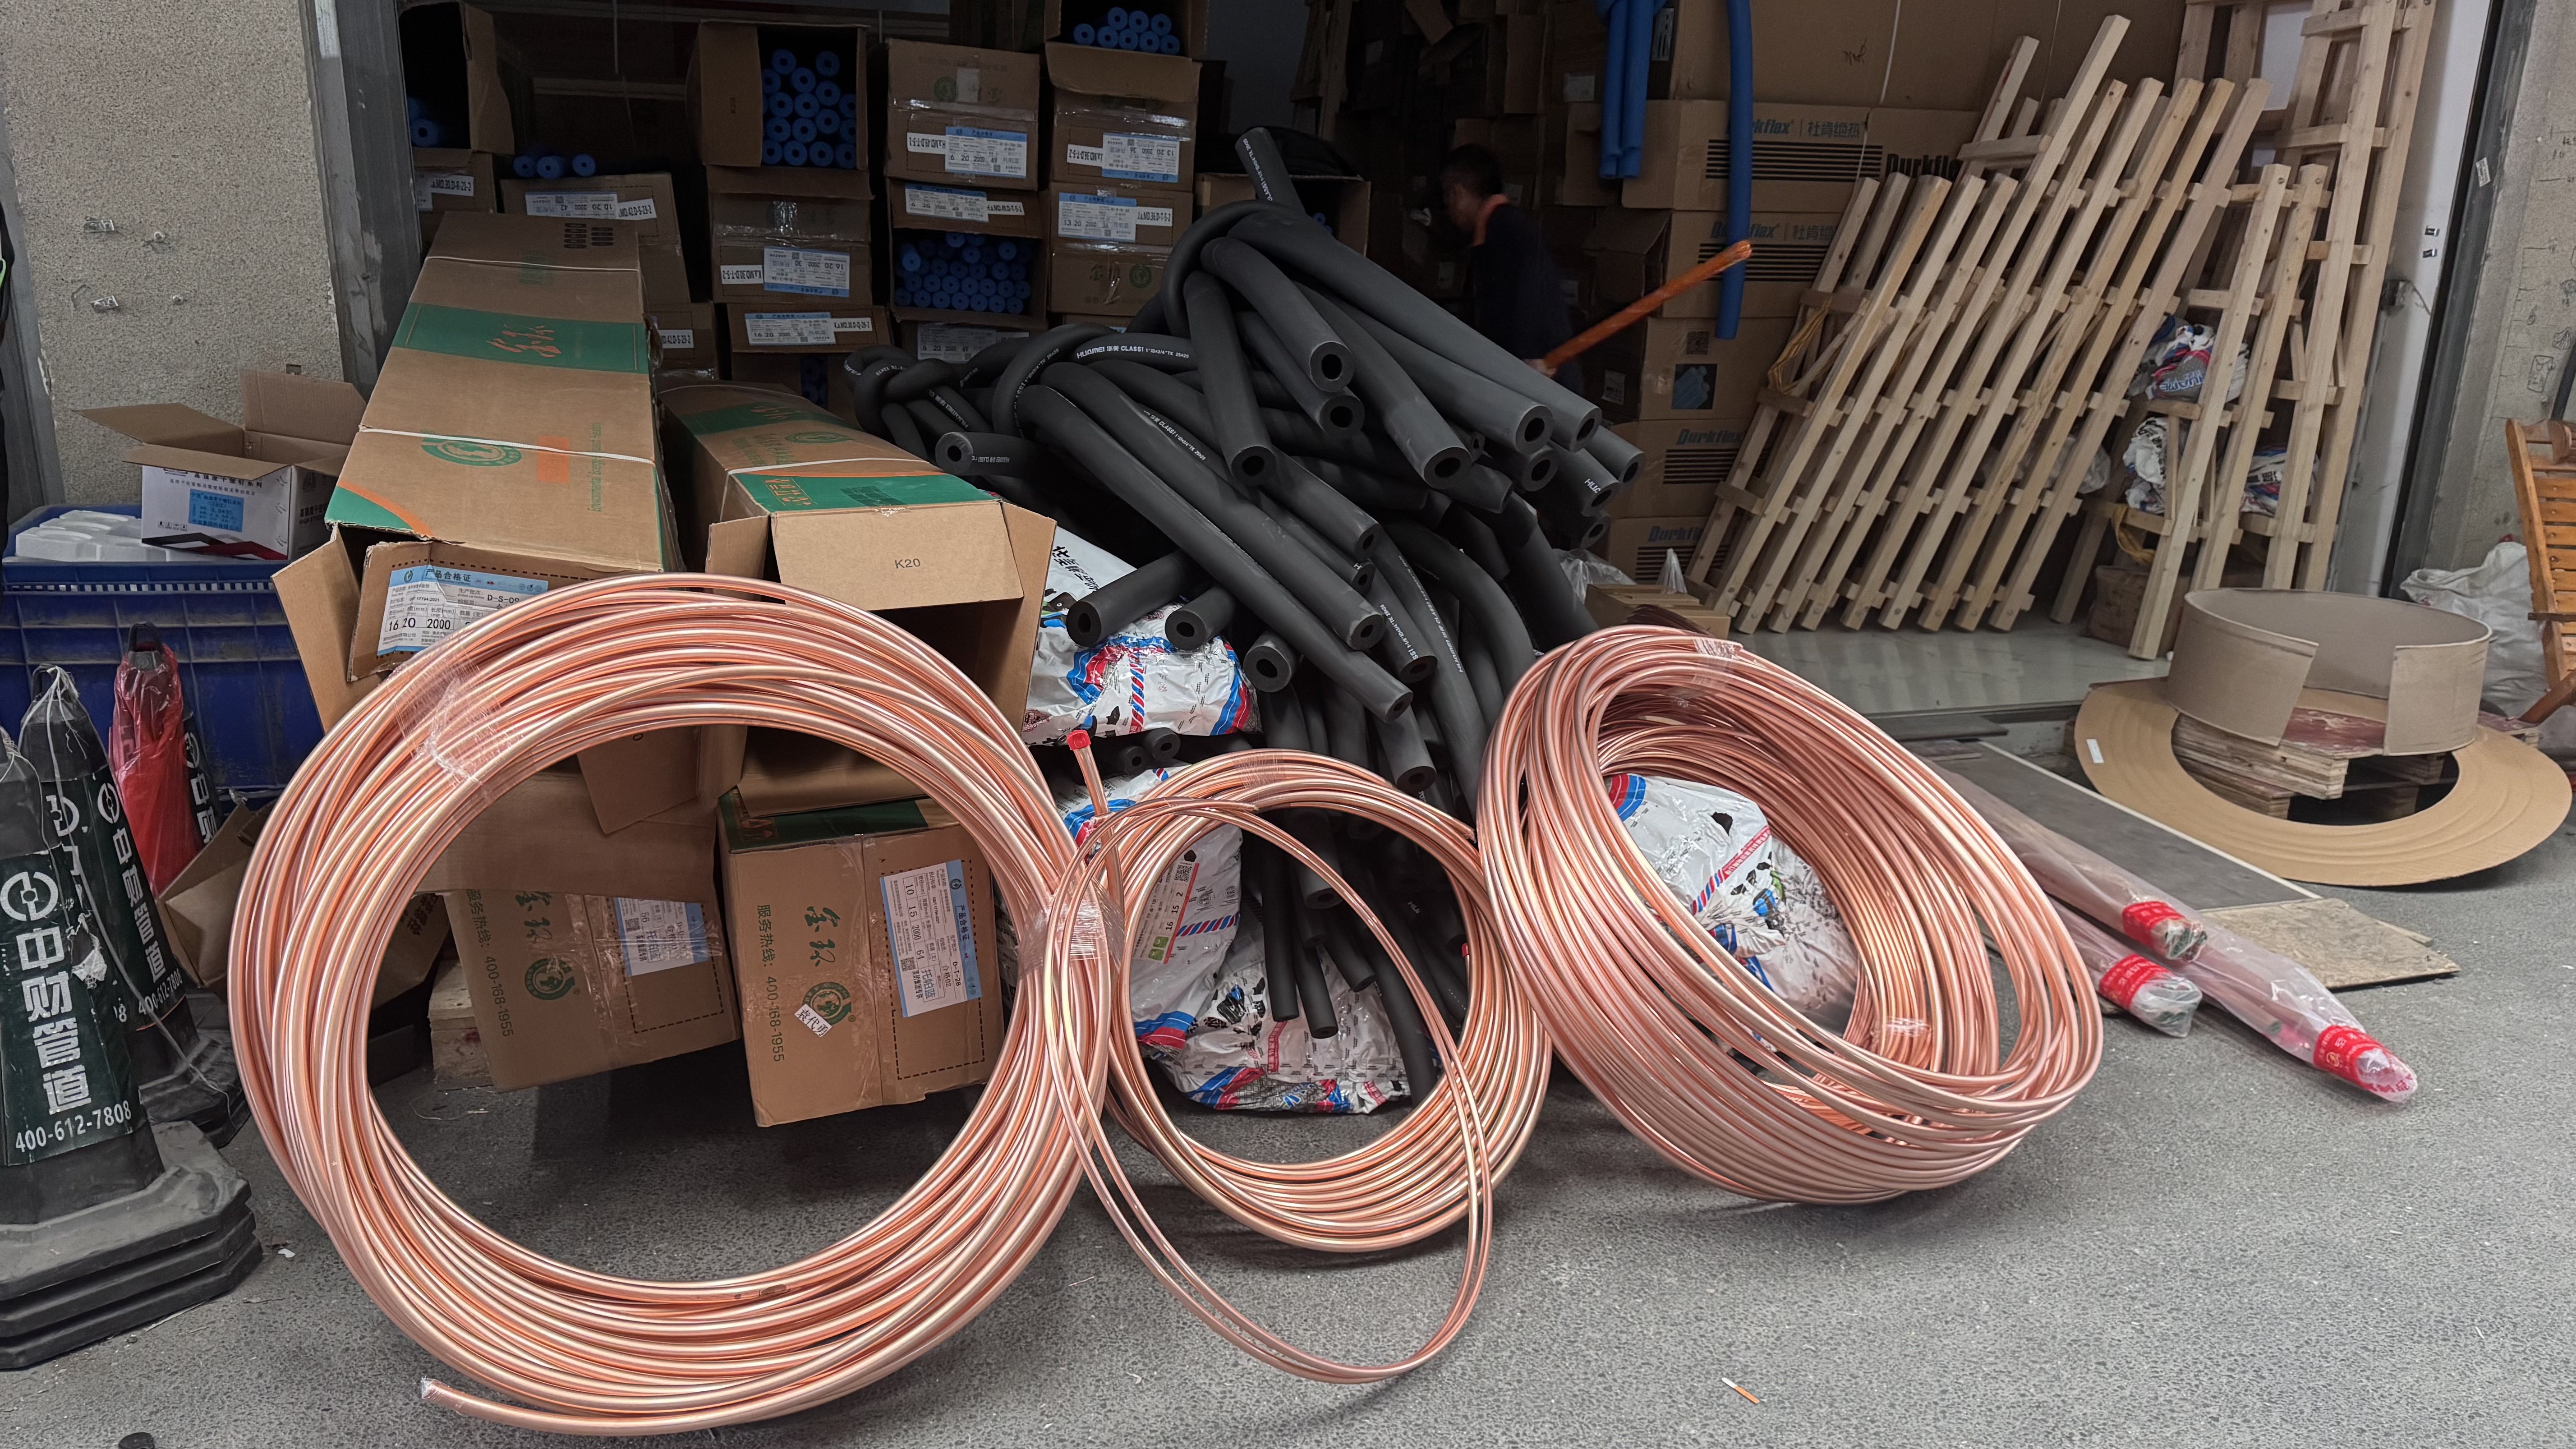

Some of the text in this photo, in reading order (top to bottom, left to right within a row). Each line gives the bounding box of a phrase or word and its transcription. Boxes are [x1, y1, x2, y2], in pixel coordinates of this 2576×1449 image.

[1076, 346, 1105, 359] HUAMEI
[894, 558, 921, 570] K20
[426, 568, 472, 583] 产品合格证
[389, 621, 399, 631] 16
[427, 619, 451, 630] 2000
[906, 884, 915, 895] 10
[112, 827, 166, 984] 中财管道
[909, 906, 917, 917] 15
[1171, 905, 1179, 914] 15
[642, 912, 650, 922] 56
[957, 905, 970, 941] 产品合格证
[912, 925, 921, 940] 2000
[1165, 921, 1173, 931] 16
[916, 950, 925, 960] 64
[943, 965, 951, 987] 合格02
[952, 961, 961, 986] D-T-28
[921, 969, 935, 999] 托帕蓝
[485, 957, 514, 1037] 400-168-1955
[16, 927, 92, 1115] 中财管道
[766, 976, 785, 1062] 400-168-1955
[796, 1009, 828, 1036] 袁代勇
[15, 1100, 132, 1153] 400-612-7808
